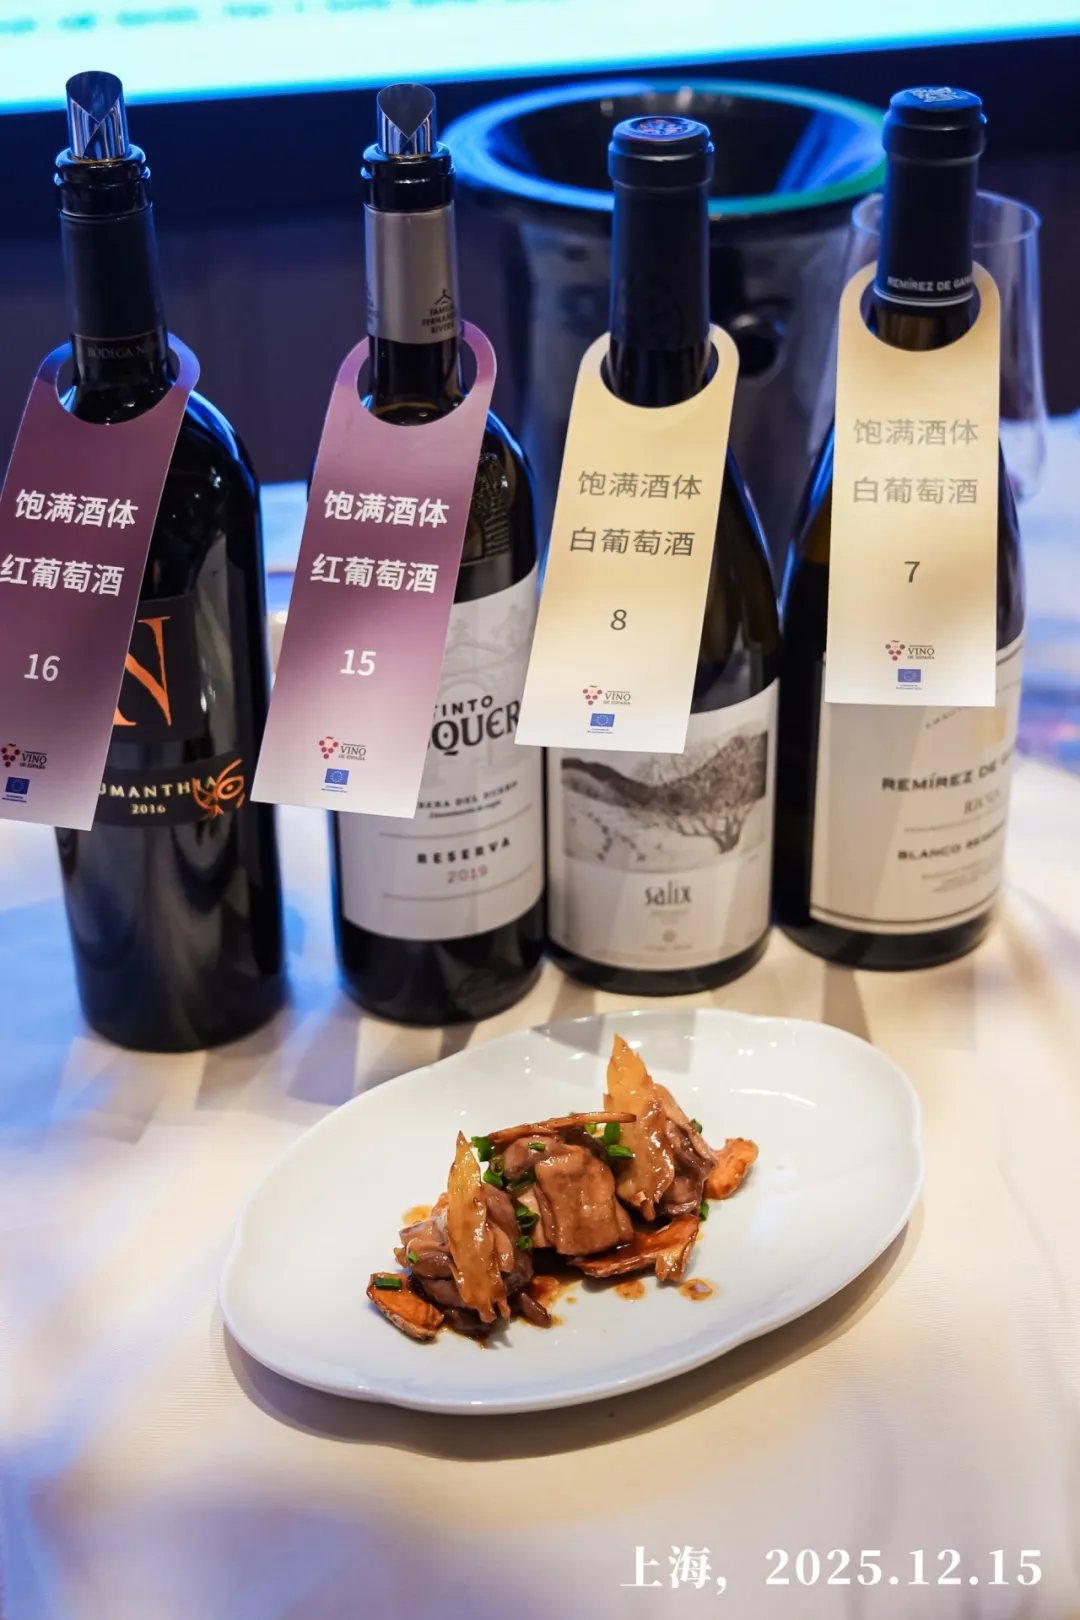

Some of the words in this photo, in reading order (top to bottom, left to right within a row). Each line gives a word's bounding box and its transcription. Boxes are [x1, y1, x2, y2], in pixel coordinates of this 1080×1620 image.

[852, 418, 979, 446] 饱满酒体
[578, 471, 702, 500] 饱满酒体
[853, 476, 978, 504] 白葡萄酒
[15, 489, 139, 529] 饱满酒体
[324, 490, 450, 528] 饱满酒体
[570, 527, 695, 556] 白葡萄酒
[0, 554, 125, 597] 红葡萄酒
[310, 553, 440, 593] 红葡萄酒
[904, 561, 921, 583] 7
[610, 609, 627, 631] 8
[340, 650, 376, 676] 15
[908, 647, 935, 656] VINO
[24, 653, 60, 681] 16
[433, 695, 494, 717] INTO
[605, 692, 631, 701] VINO
[22, 753, 47, 765] VINO
[341, 745, 367, 756] VINO
[131, 804, 166, 815] 2016
[417, 837, 511, 865] RESERVA
[645, 880, 692, 907] salix
